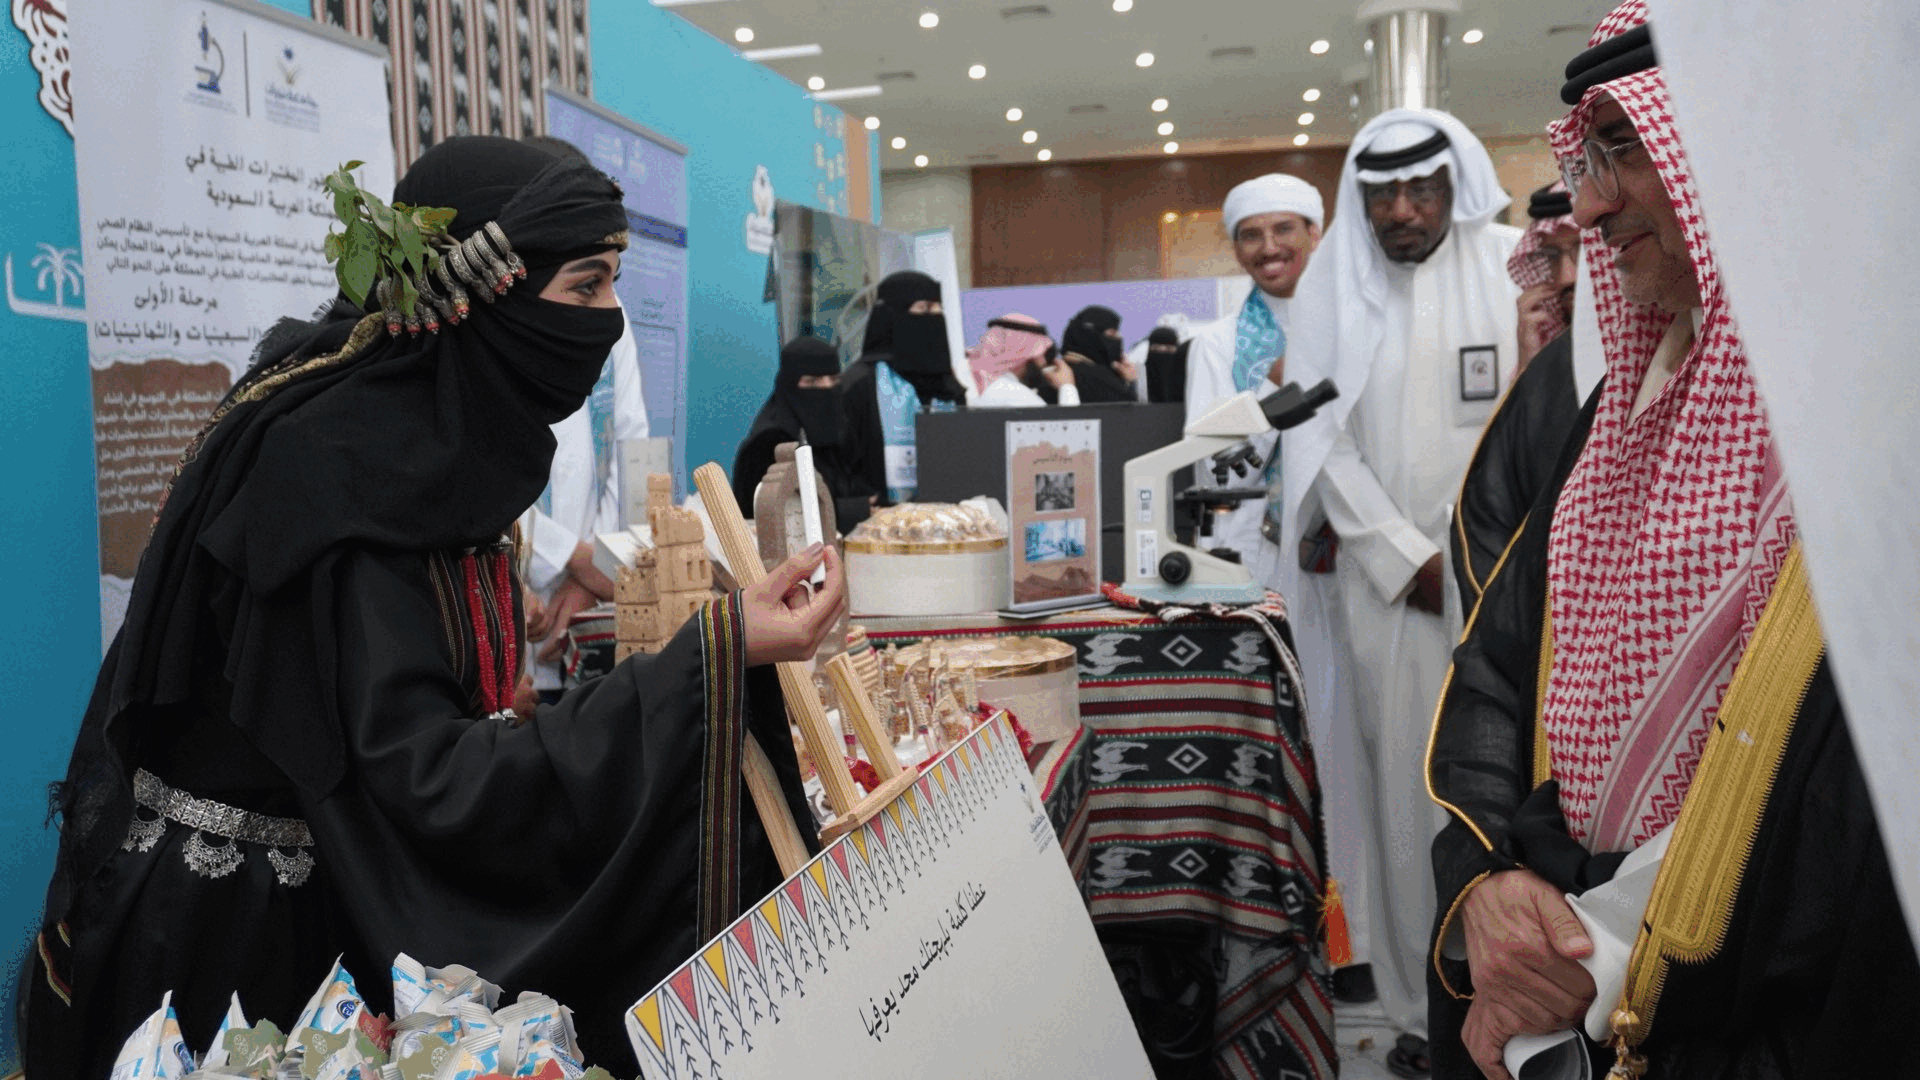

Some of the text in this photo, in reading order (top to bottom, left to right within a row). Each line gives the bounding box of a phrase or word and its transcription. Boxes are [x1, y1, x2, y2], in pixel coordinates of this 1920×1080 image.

[185, 145, 205, 173] في
[209, 148, 244, 174] الطبية
[249, 158, 304, 184] المختبرات
[207, 180, 263, 211] السعودية
[268, 190, 303, 218] العربية
[128, 218, 153, 235] النظام
[134, 281, 217, 314] مرحلة الأولى
